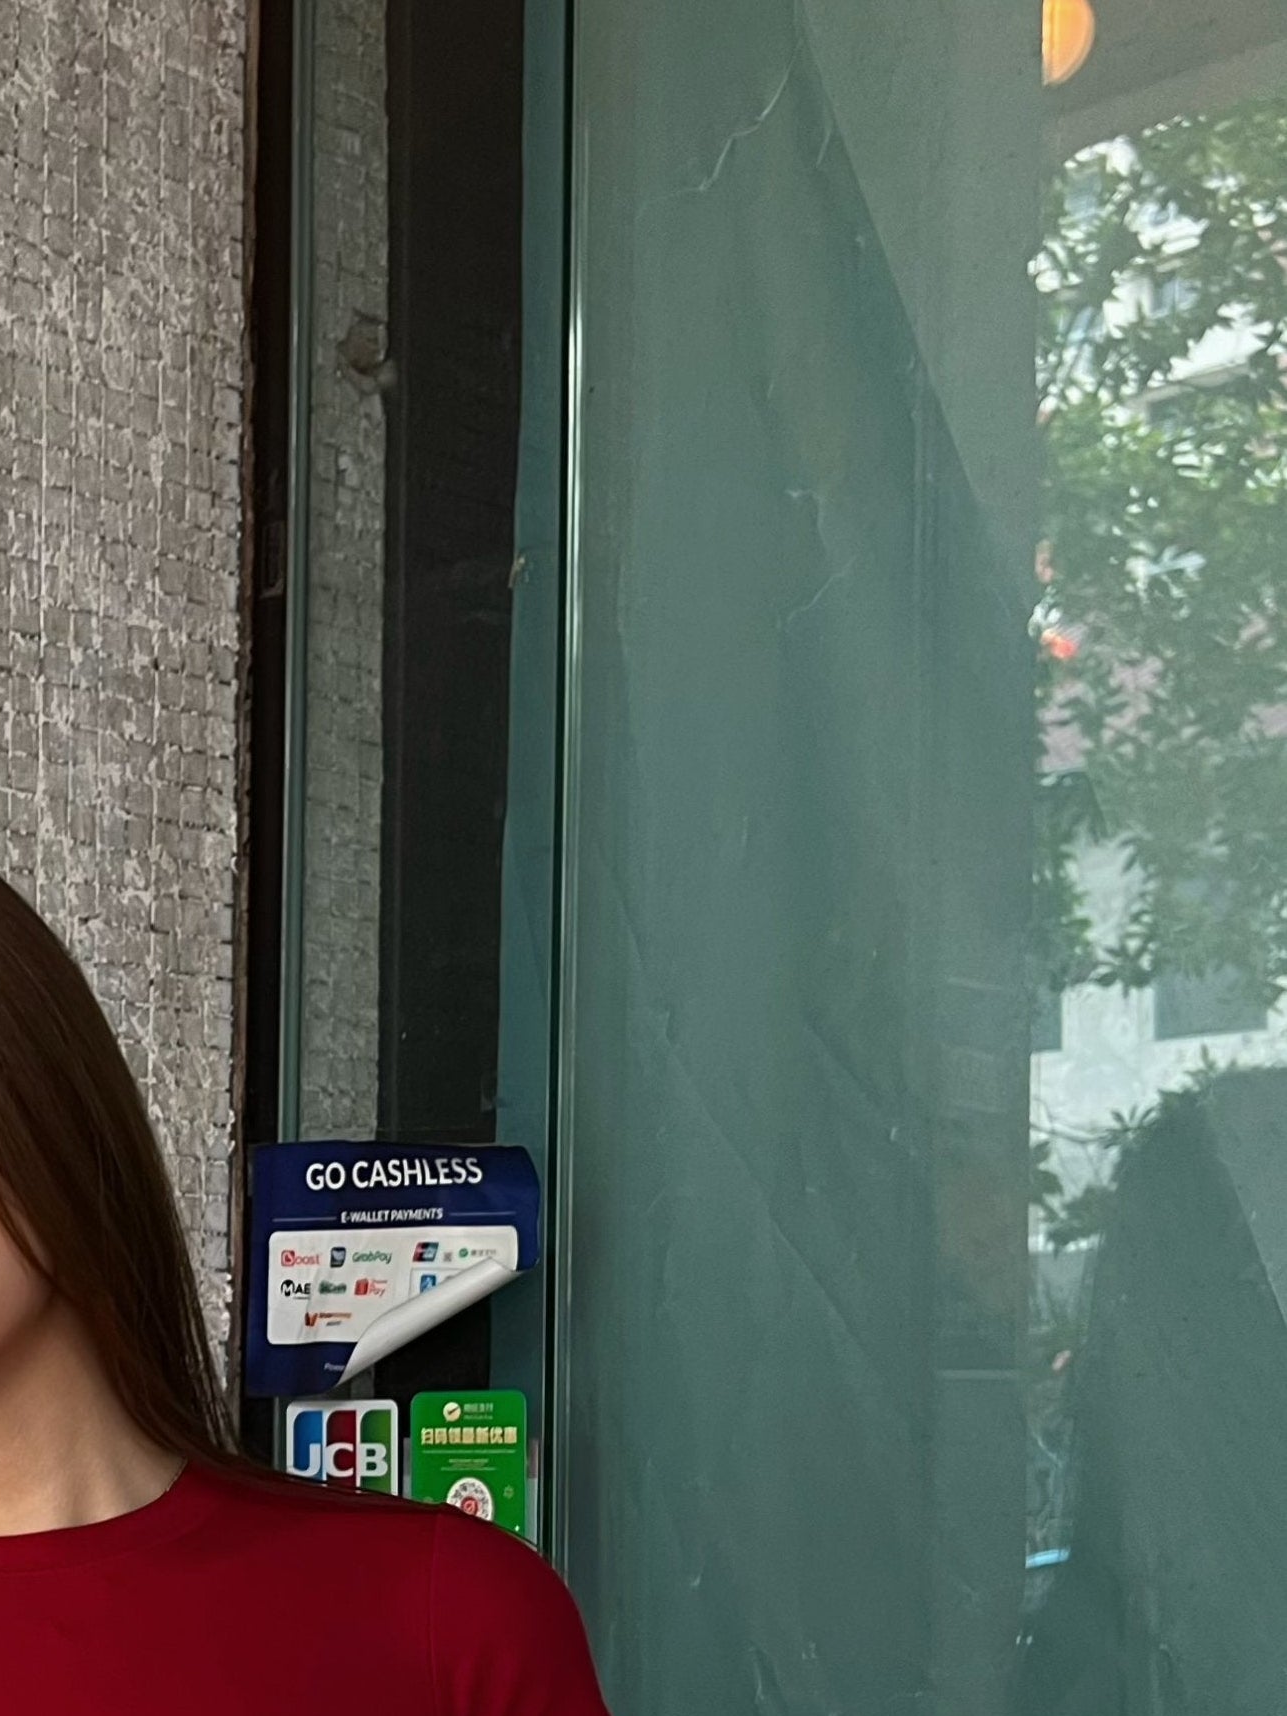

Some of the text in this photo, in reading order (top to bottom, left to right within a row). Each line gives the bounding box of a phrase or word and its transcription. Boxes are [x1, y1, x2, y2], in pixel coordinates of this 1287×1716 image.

[306, 1157, 483, 1190] GO CASHLESS
[340, 1207, 444, 1223] E-WALLET PAYMENTS
[290, 1442, 389, 1478] JCB
